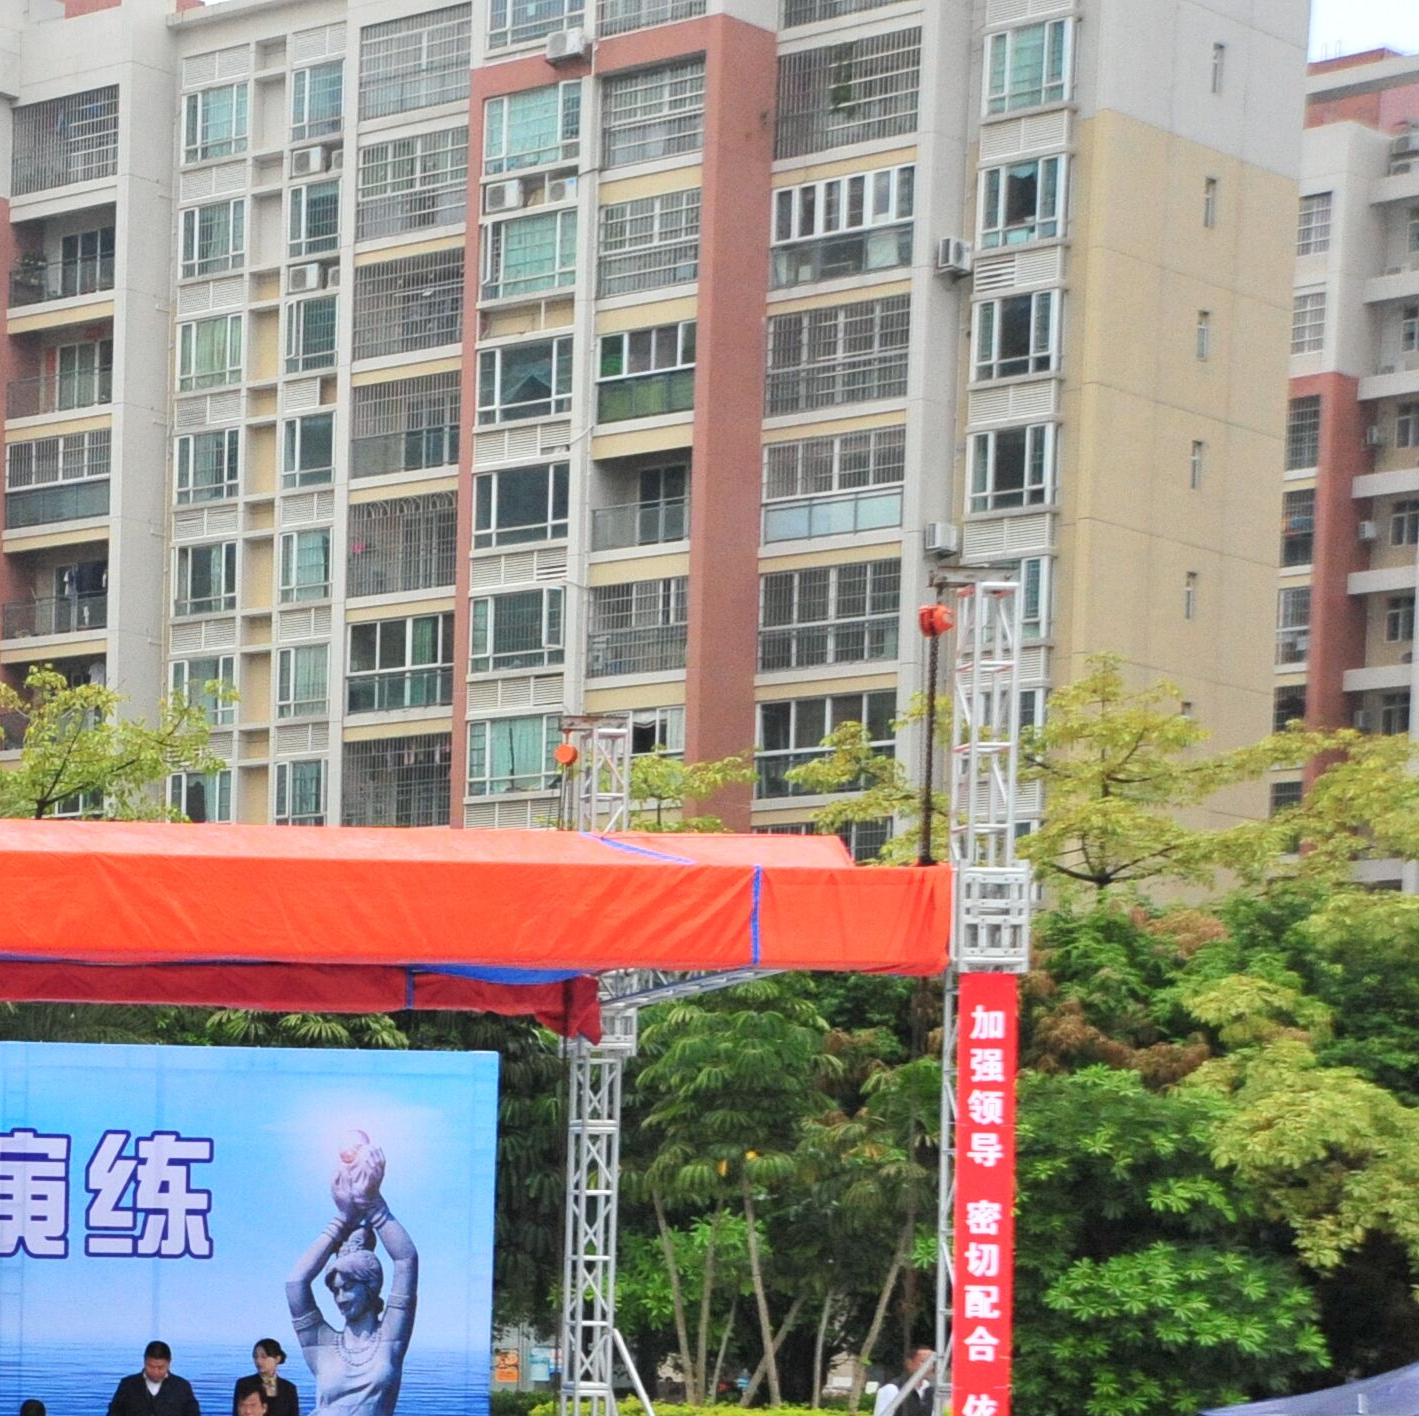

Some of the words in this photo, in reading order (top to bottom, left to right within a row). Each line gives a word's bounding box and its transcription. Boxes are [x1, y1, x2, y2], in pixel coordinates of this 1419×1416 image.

[966, 1004, 1007, 1169] 加强领导
[963, 1199, 1002, 1363] 密切配合
